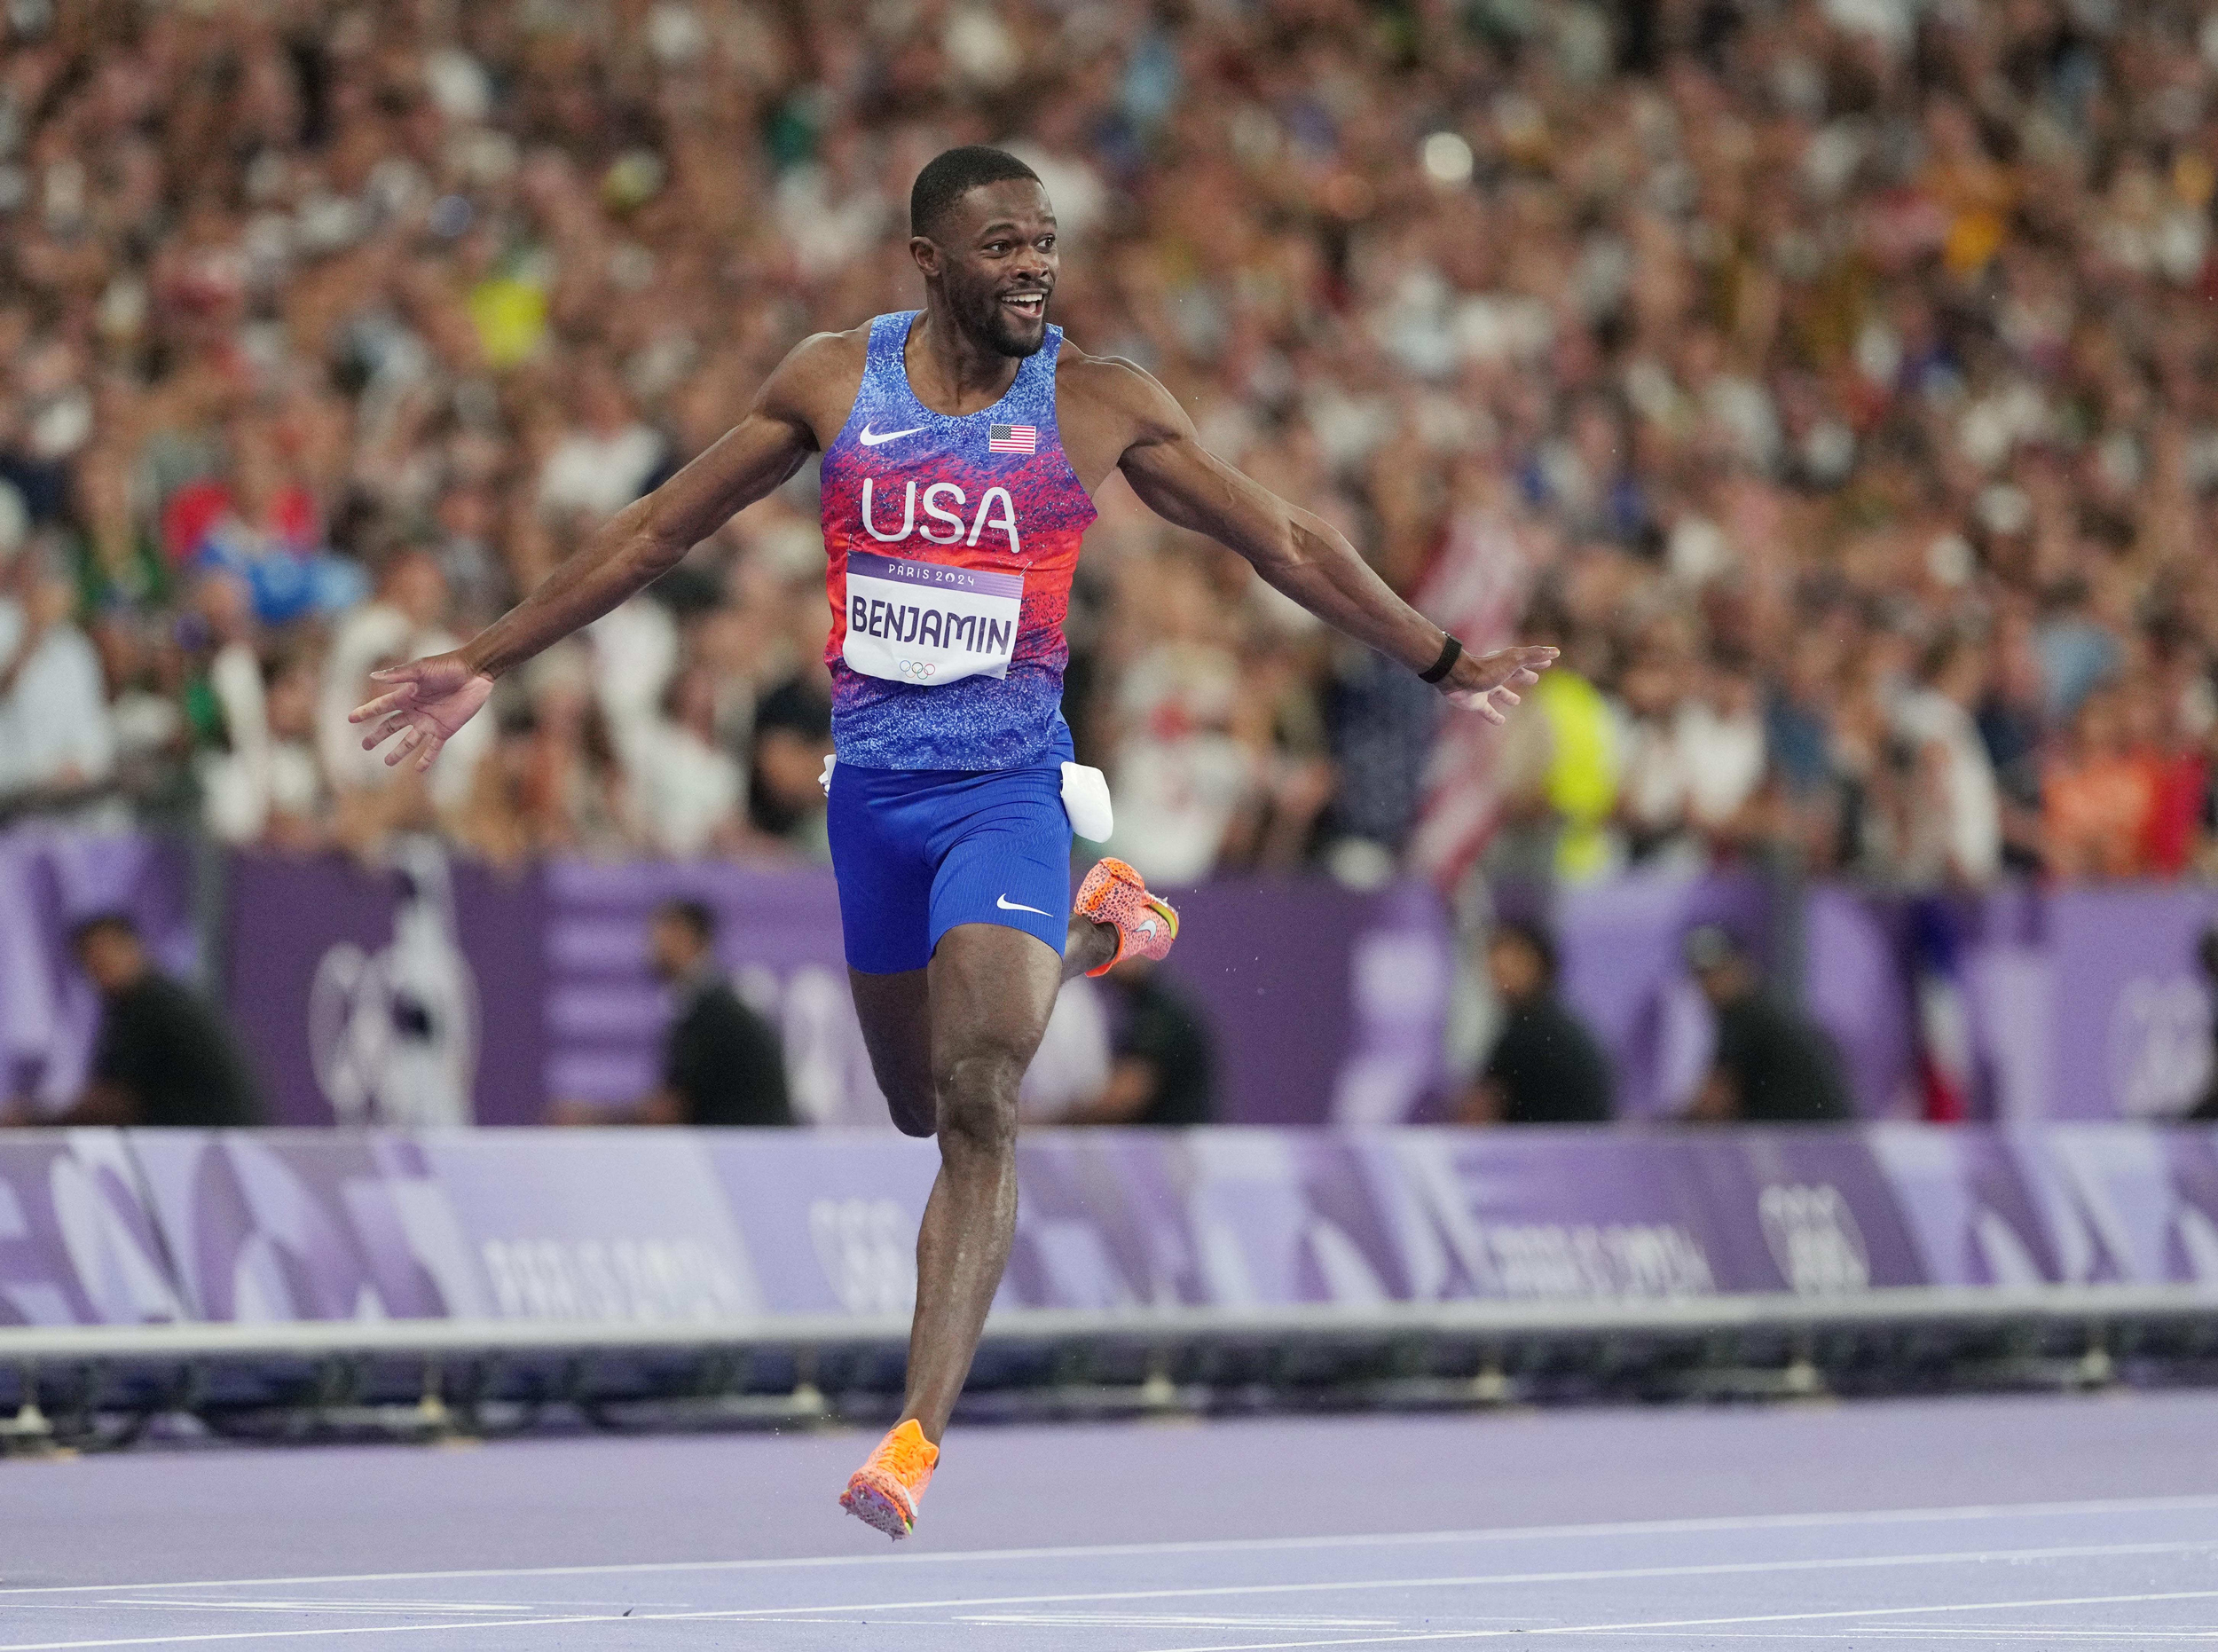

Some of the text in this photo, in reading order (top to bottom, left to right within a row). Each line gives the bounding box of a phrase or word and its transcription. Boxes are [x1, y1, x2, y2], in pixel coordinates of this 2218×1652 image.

[861, 477, 1020, 554] USA
[888, 562, 975, 586] PARIS 2024
[852, 595, 1011, 656] BENJAMIN
